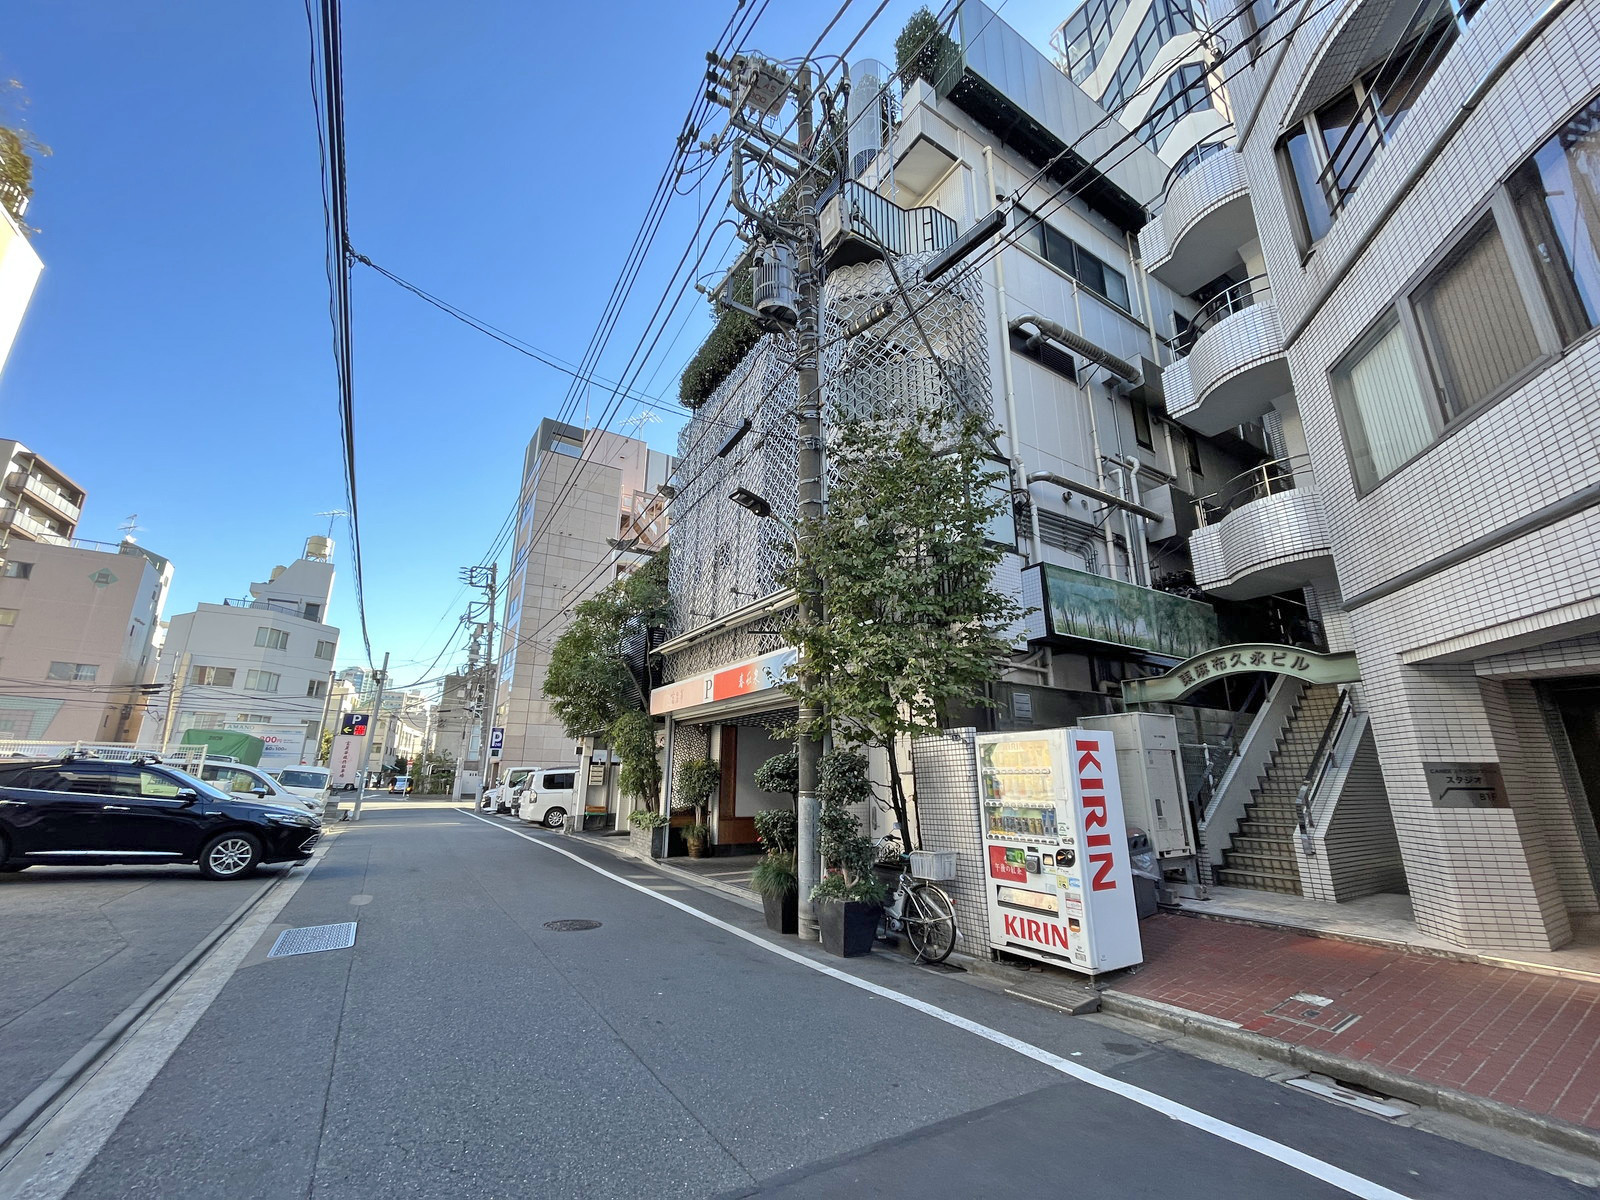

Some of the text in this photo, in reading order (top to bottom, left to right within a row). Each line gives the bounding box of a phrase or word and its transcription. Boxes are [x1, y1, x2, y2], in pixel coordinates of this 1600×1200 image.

[1177, 651, 1310, 687] 東麻布久永ビル
[705, 679, 713, 699] P
[352, 714, 362, 724] P
[492, 731, 502, 746] P
[1446, 776, 1482, 784] スタジオ
[1076, 740, 1117, 892] KIRIN
[1004, 914, 1069, 950] KIRIN
